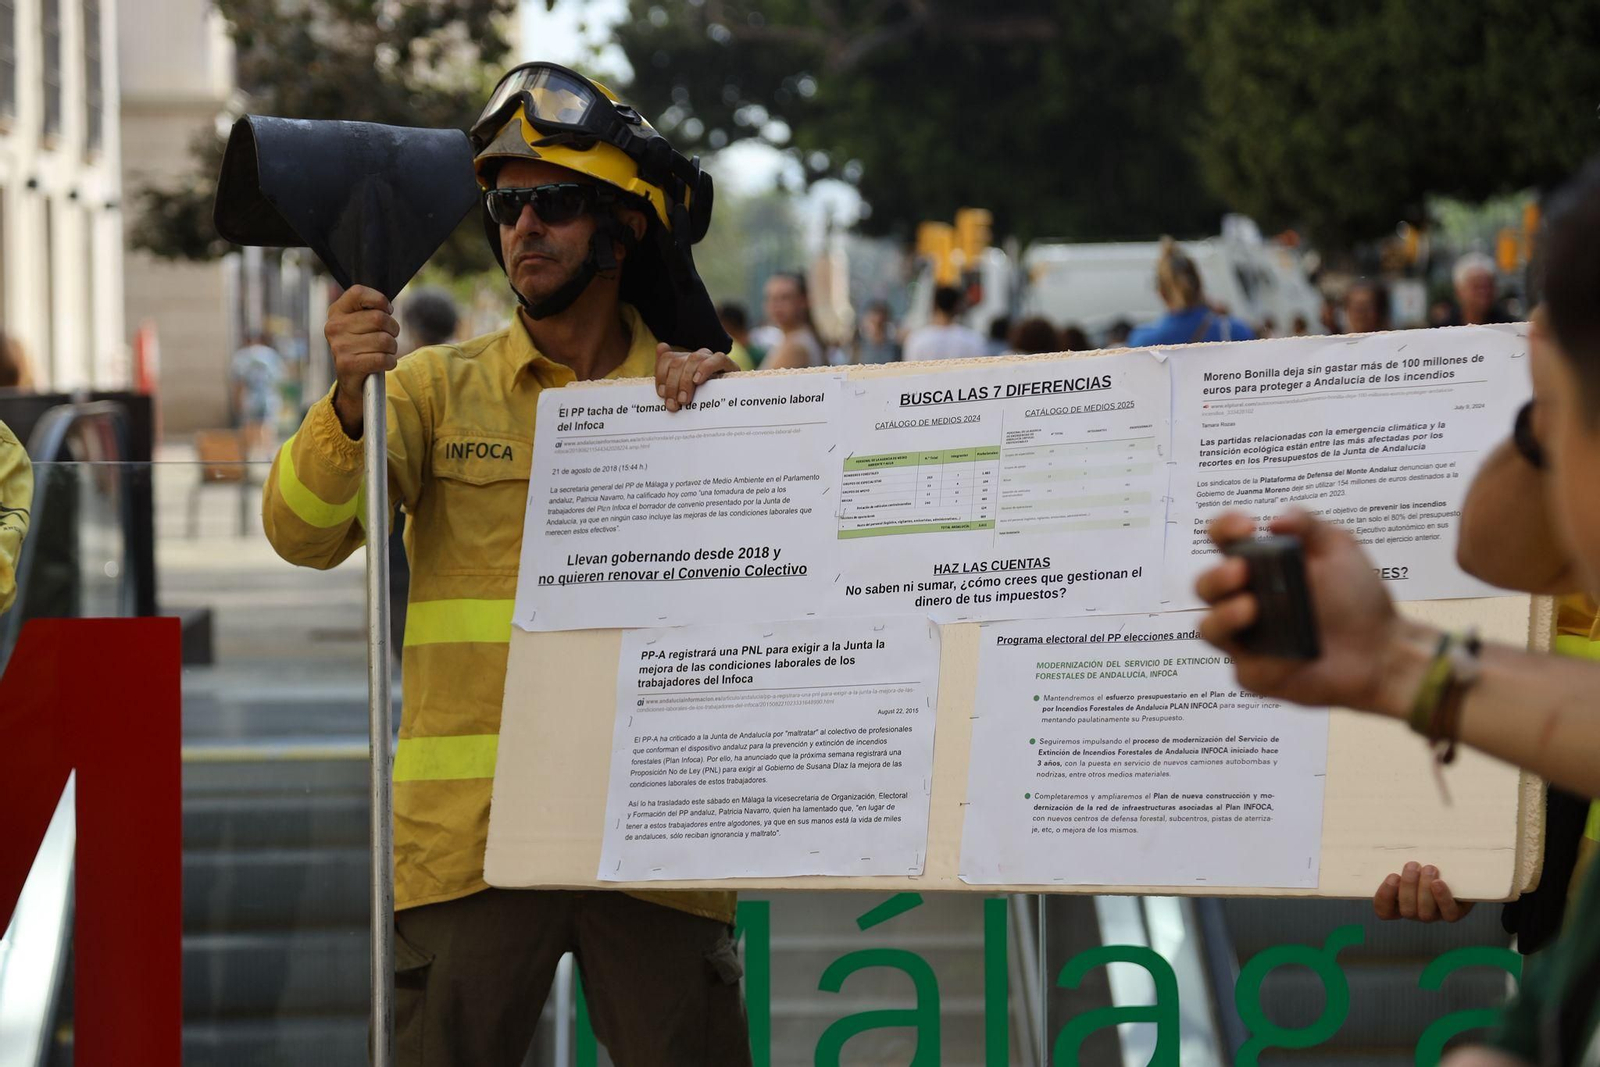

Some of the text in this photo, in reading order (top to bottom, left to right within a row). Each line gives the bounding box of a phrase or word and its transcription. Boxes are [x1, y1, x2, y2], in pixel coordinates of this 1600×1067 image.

[1203, 354, 1484, 381] Moreno Bonilla deja sin gastar más de 100 millones de
[900, 375, 1111, 405] BUSCA LAS 7 DIFERENCIAS
[1202, 370, 1454, 395] euros para proteger a Andalucía de los incendios
[558, 408, 568, 417] El
[570, 406, 584, 416] PP
[587, 406, 613, 416] tacha
[616, 405, 628, 414] de
[686, 402, 697, 410] de
[728, 397, 737, 406] el
[740, 396, 786, 406] convenio
[789, 392, 824, 403] laboral
[1024, 400, 1135, 417] CATÁLOGO DE MEDIOS 2025
[557, 420, 604, 431] del Infoca
[874, 414, 981, 429] CATÁLOGO DE MEDIOS 2024
[1200, 438, 1215, 446] Las
[1217, 436, 1251, 446] partidas
[1253, 432, 1306, 442] relacionadas
[1335, 426, 1385, 436] emergencia
[1388, 423, 1427, 431] climática
[446, 442, 513, 461] INFOCA
[570, 467, 591, 475] agosto
[601, 464, 617, 472] 2018
[567, 546, 781, 566] Llevan gobernando desde 2018 y
[538, 563, 807, 586] no quieren renovar el Convenio Colectivo
[933, 557, 1050, 575] HAZ LAS CUENTAS
[845, 566, 1142, 595] No saben ni sumar, ¿cómo crees que gestionan el
[914, 588, 1066, 606] dinero de tus impuestos?
[996, 636, 1043, 645] Programa
[1045, 634, 1087, 643] electoral
[1089, 633, 1104, 642] del
[1107, 633, 1121, 642] PP
[1123, 632, 1173, 641] elecciones
[640, 650, 665, 660] PP-A
[668, 647, 716, 660] registrará
[719, 648, 738, 656] una
[741, 645, 762, 655] PNL
[765, 646, 788, 656] para
[791, 642, 820, 654] exigir
[831, 641, 840, 651] la
[843, 640, 872, 650] Junta
[875, 639, 884, 648] la
[638, 655, 855, 676] mejora de las condiciones laborales de los
[1036, 660, 1103, 669] MODERNIZACIÓN
[1124, 659, 1160, 667] SERVICIO
[1162, 658, 1173, 666] DE
[1176, 657, 1220, 665] EXTINCIÓN
[637, 674, 753, 688] trabajadores del Infoca
[1086, 671, 1097, 679] DE
[1149, 669, 1177, 677] INFOCA
[1200, 746, 1228, 754] INFOCA
[726, 777, 767, 785] trabajadores.
